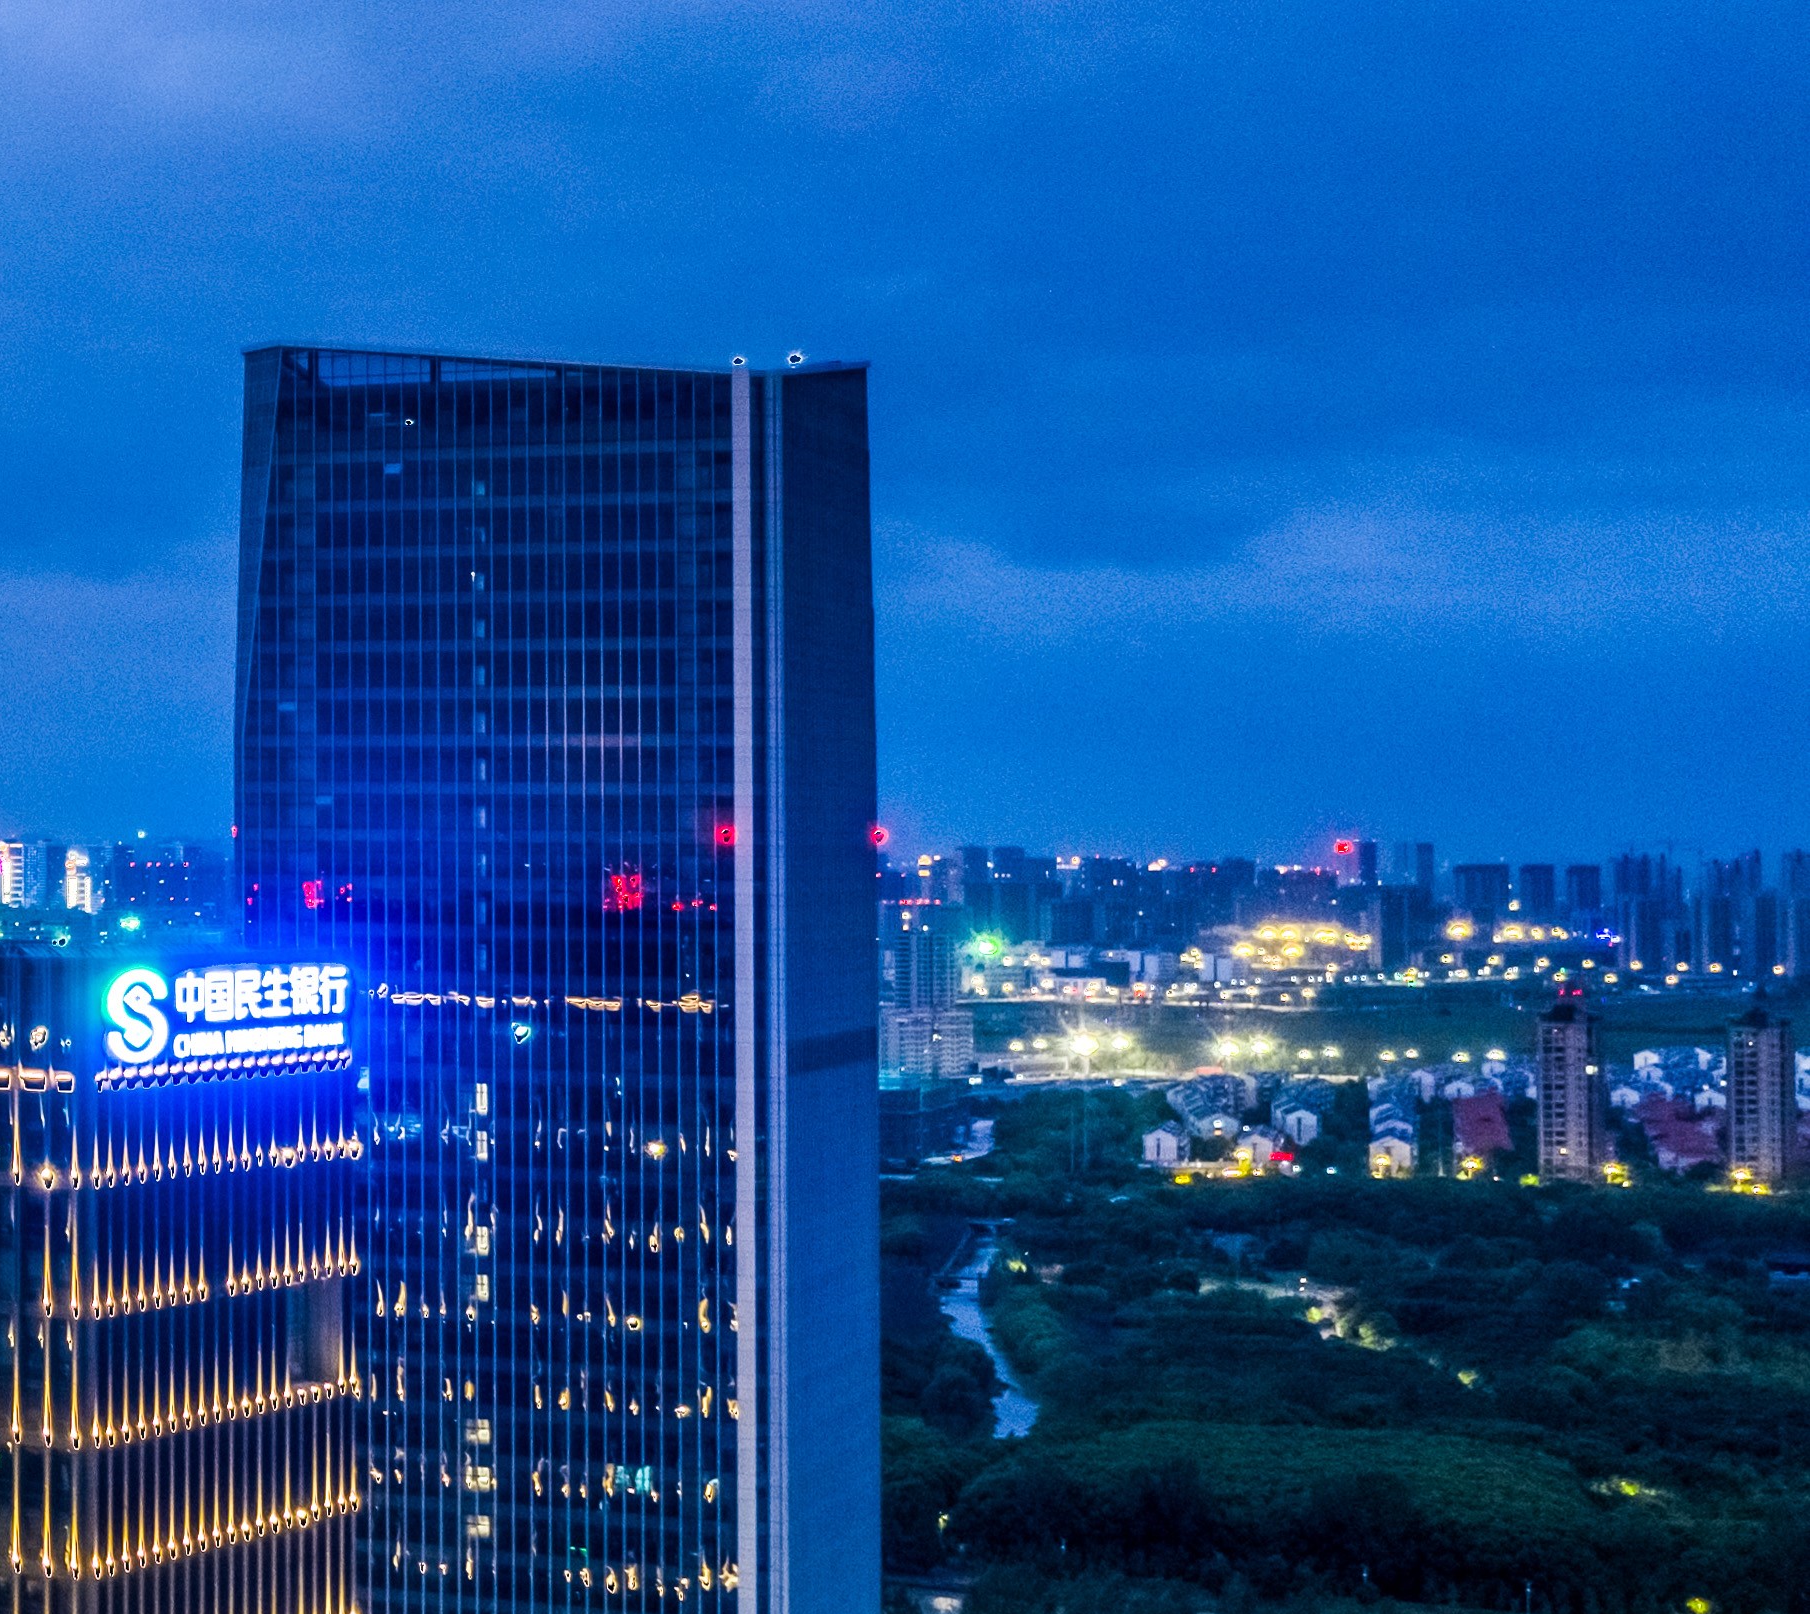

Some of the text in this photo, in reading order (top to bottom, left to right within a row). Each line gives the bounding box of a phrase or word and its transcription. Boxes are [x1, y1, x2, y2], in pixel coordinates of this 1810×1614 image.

[175, 966, 347, 1022] 中国民生银行
